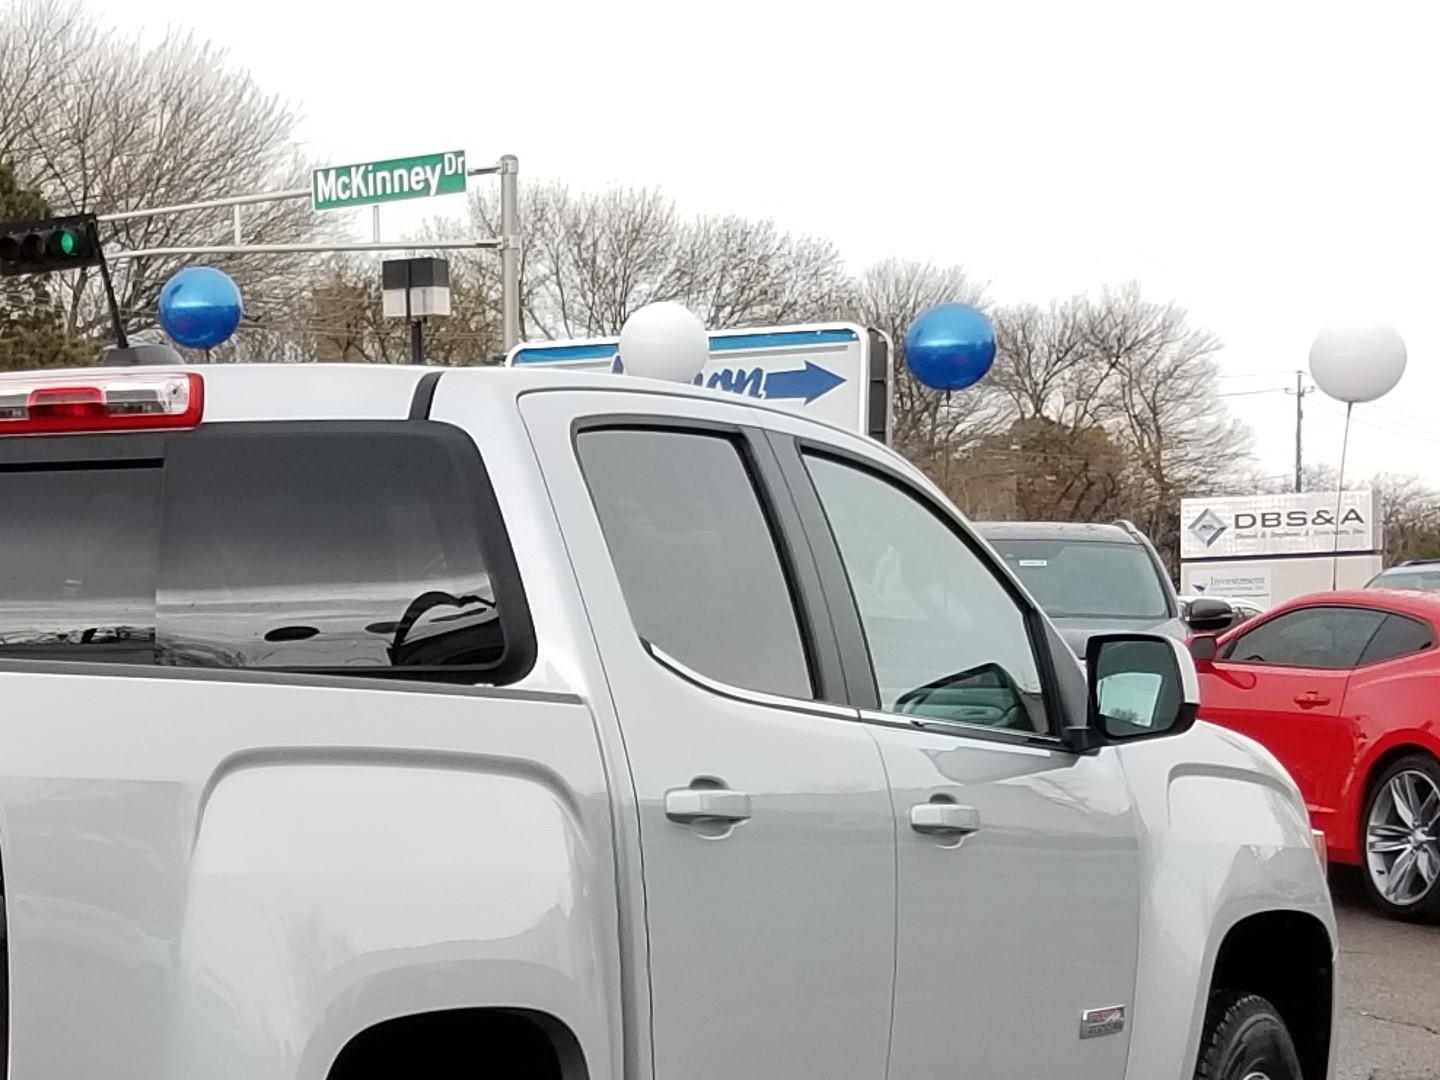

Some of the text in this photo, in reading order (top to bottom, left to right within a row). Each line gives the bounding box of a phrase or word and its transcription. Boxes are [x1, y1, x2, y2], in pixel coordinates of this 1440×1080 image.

[317, 153, 465, 203] McKinney Dr
[1234, 509, 1365, 529] DBS&A
[1210, 575, 1266, 586] Investment
